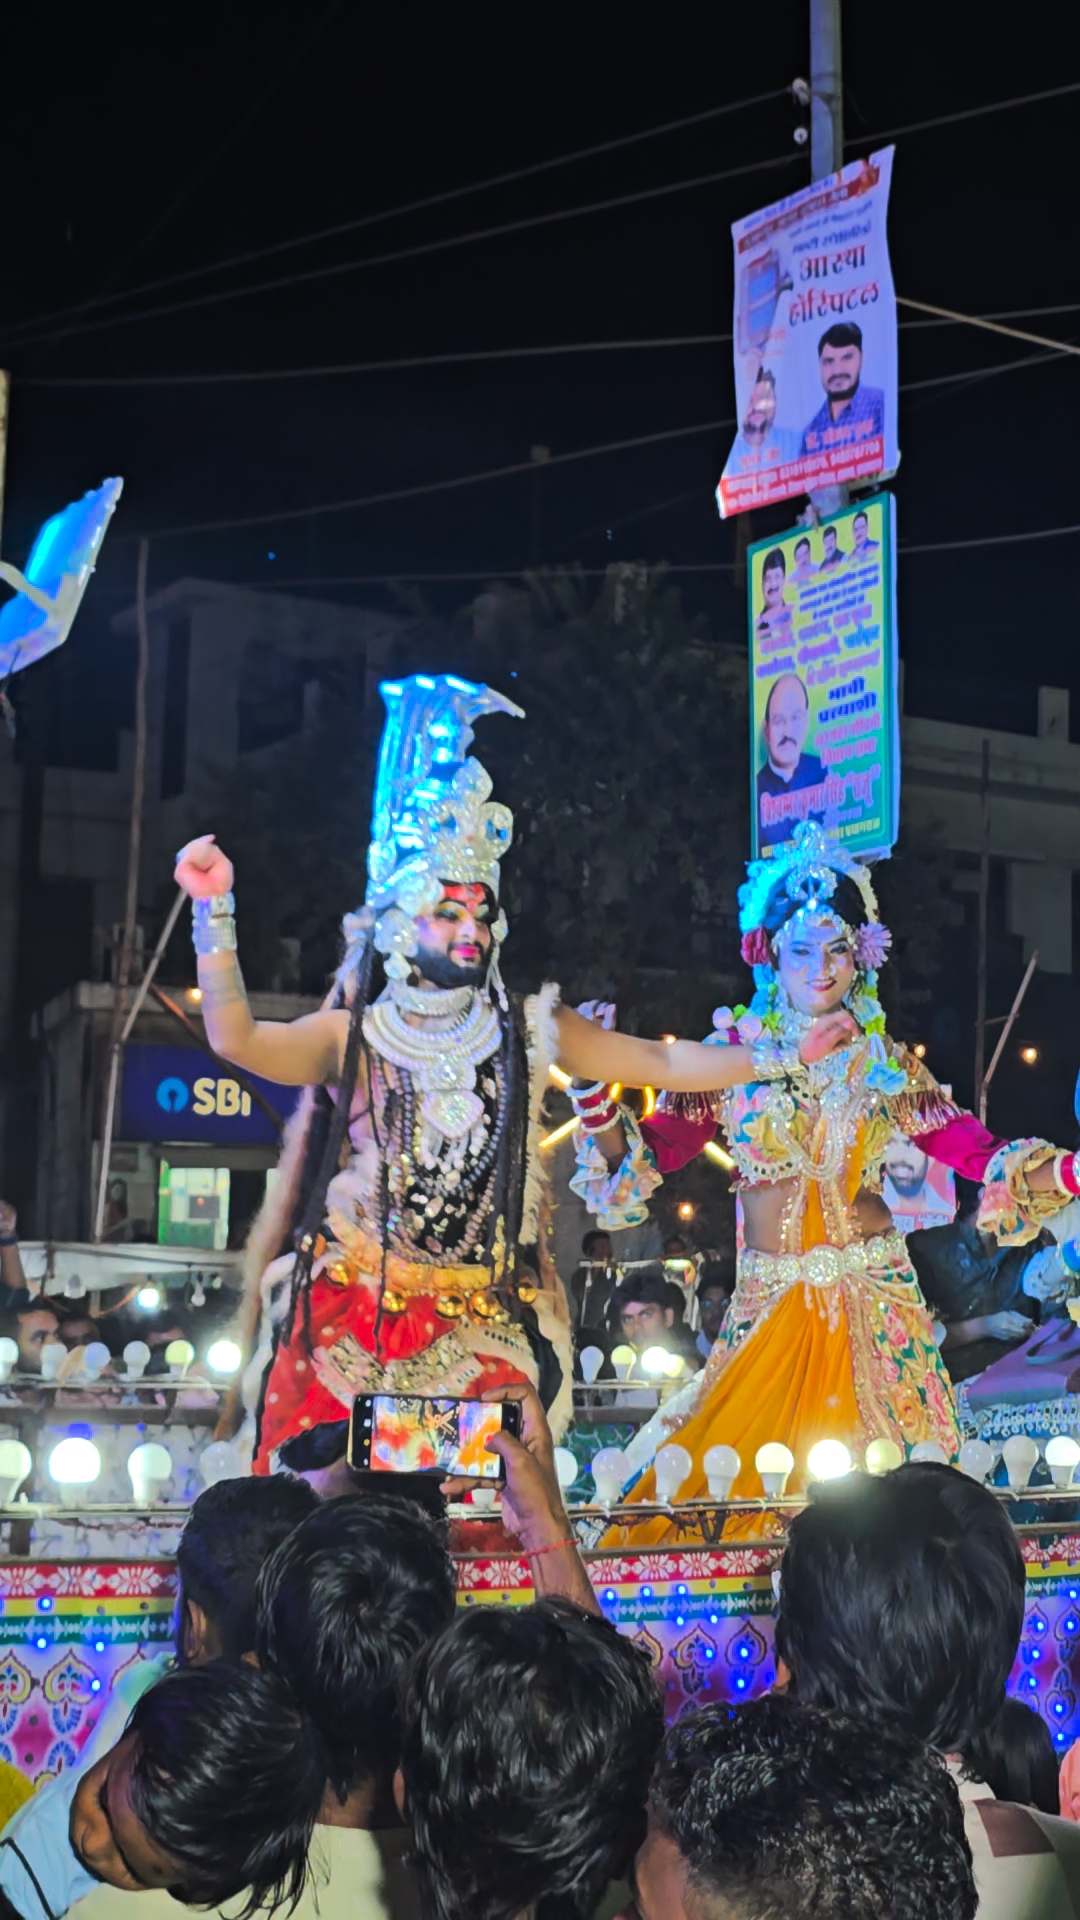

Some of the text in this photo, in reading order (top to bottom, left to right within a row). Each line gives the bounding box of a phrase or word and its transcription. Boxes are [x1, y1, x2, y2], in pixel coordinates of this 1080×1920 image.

[800, 245, 866, 282] आस्था
[829, 677, 865, 700] भावी
[193, 1077, 252, 1117] SBI
